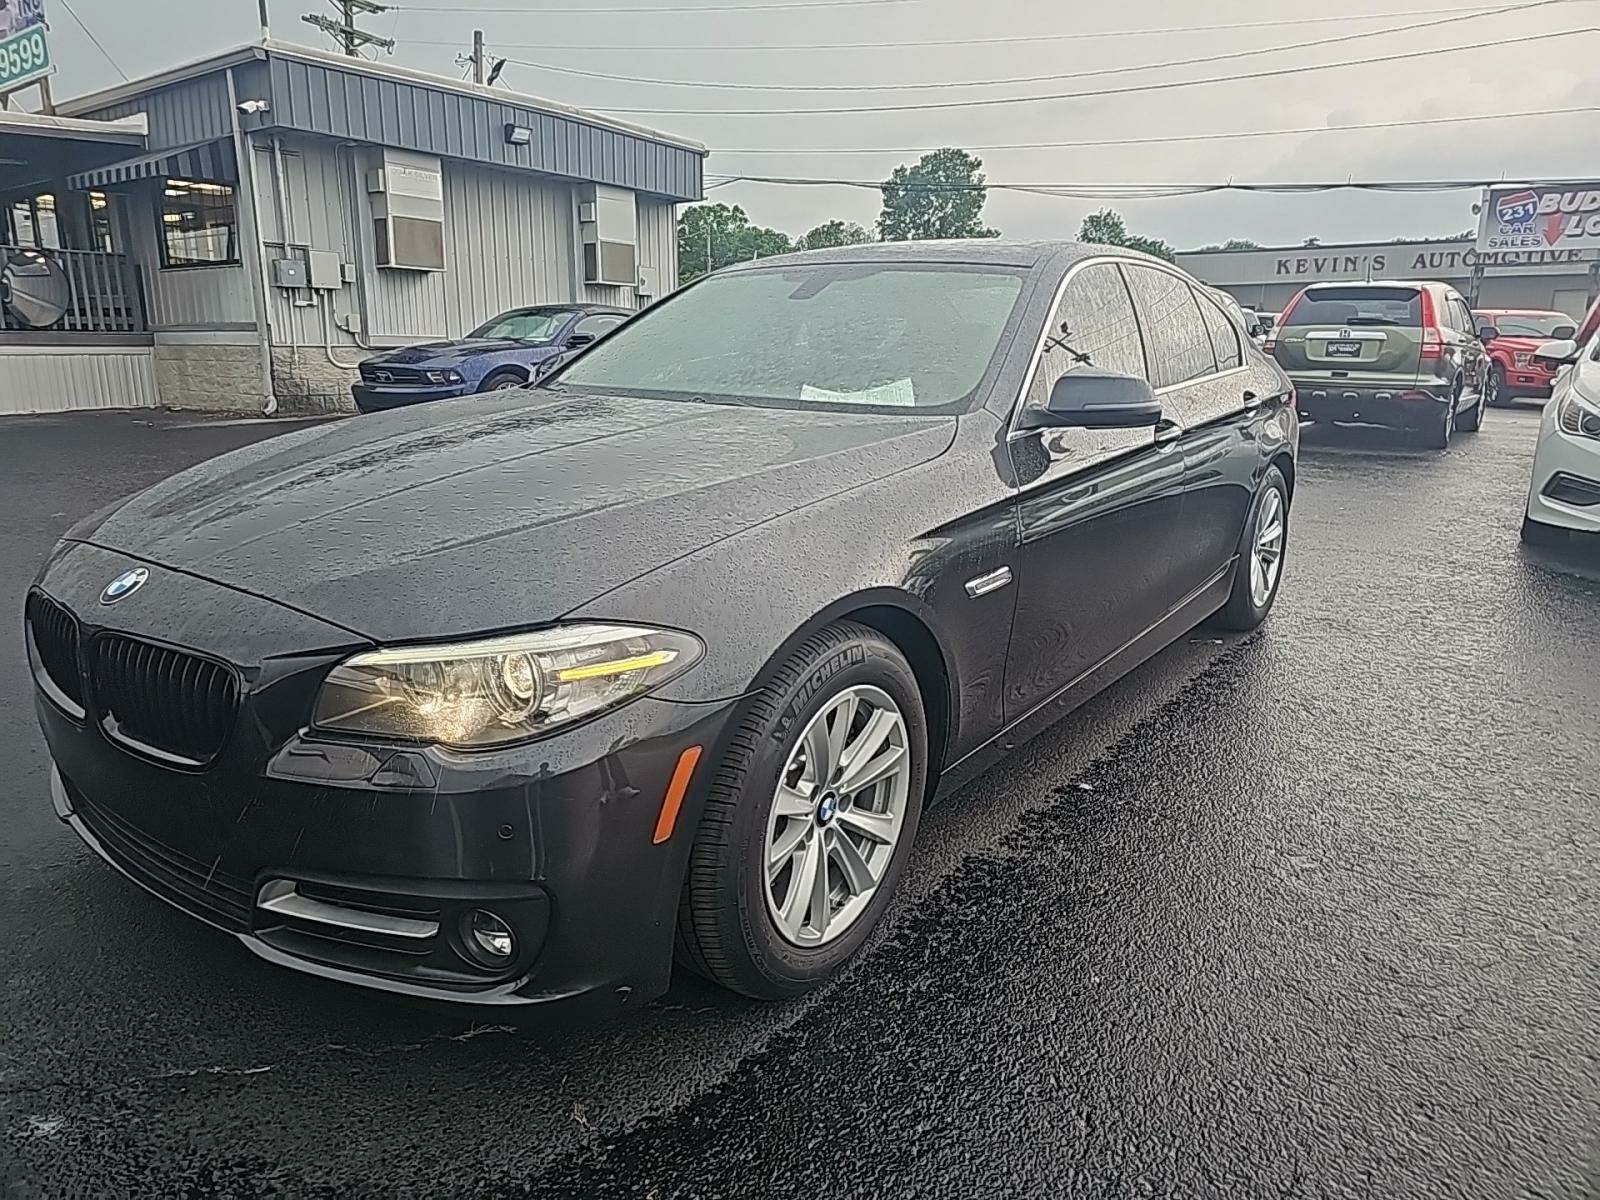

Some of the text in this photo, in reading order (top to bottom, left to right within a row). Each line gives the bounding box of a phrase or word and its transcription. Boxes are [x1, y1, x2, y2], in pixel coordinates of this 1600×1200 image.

[0, 33, 44, 78] 9599
[1502, 203, 1534, 220] 231
[1500, 223, 1535, 235] CAR
[1489, 237, 1541, 248] SALES
[1275, 249, 1584, 275] KEVIN'S AUTOMOTIVE
[790, 644, 866, 717] MICHELIN
